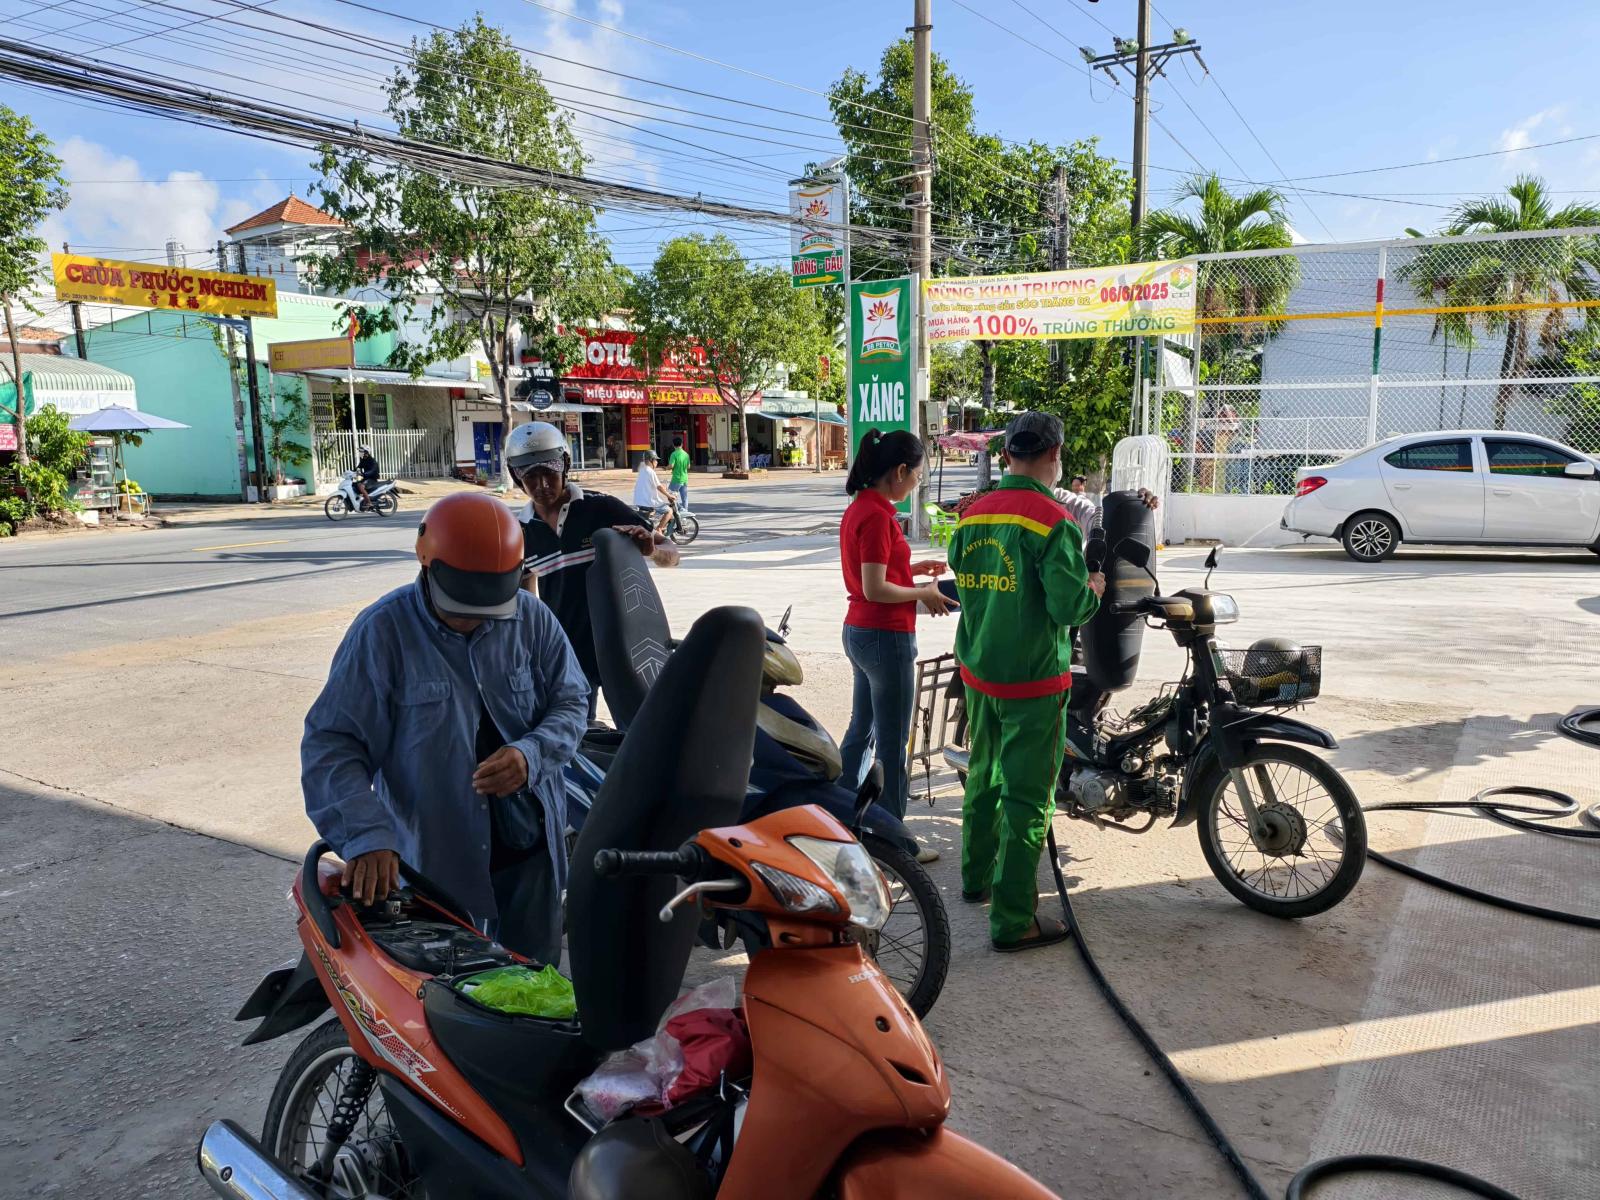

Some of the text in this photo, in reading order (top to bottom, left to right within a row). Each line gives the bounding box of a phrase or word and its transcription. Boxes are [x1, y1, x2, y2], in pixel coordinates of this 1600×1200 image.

[793, 258, 817, 275] XĂNG
[825, 250, 843, 272] DẦU
[65, 261, 267, 301] CHÙA PHƯỚC NGHIÊM
[927, 279, 1096, 299] MỪNG KHAI TRƯƠNG
[1100, 282, 1169, 303] 06/6/2025
[928, 315, 970, 327] MUA HÀNG
[973, 315, 1176, 336] 100% TRÚNG THƯỞNG
[929, 327, 970, 339] BỐC PHIẾU
[585, 341, 635, 367] OTU
[875, 341, 895, 349] PETRO
[858, 374, 905, 422] XĂNG
[967, 539, 982, 553] MTV
